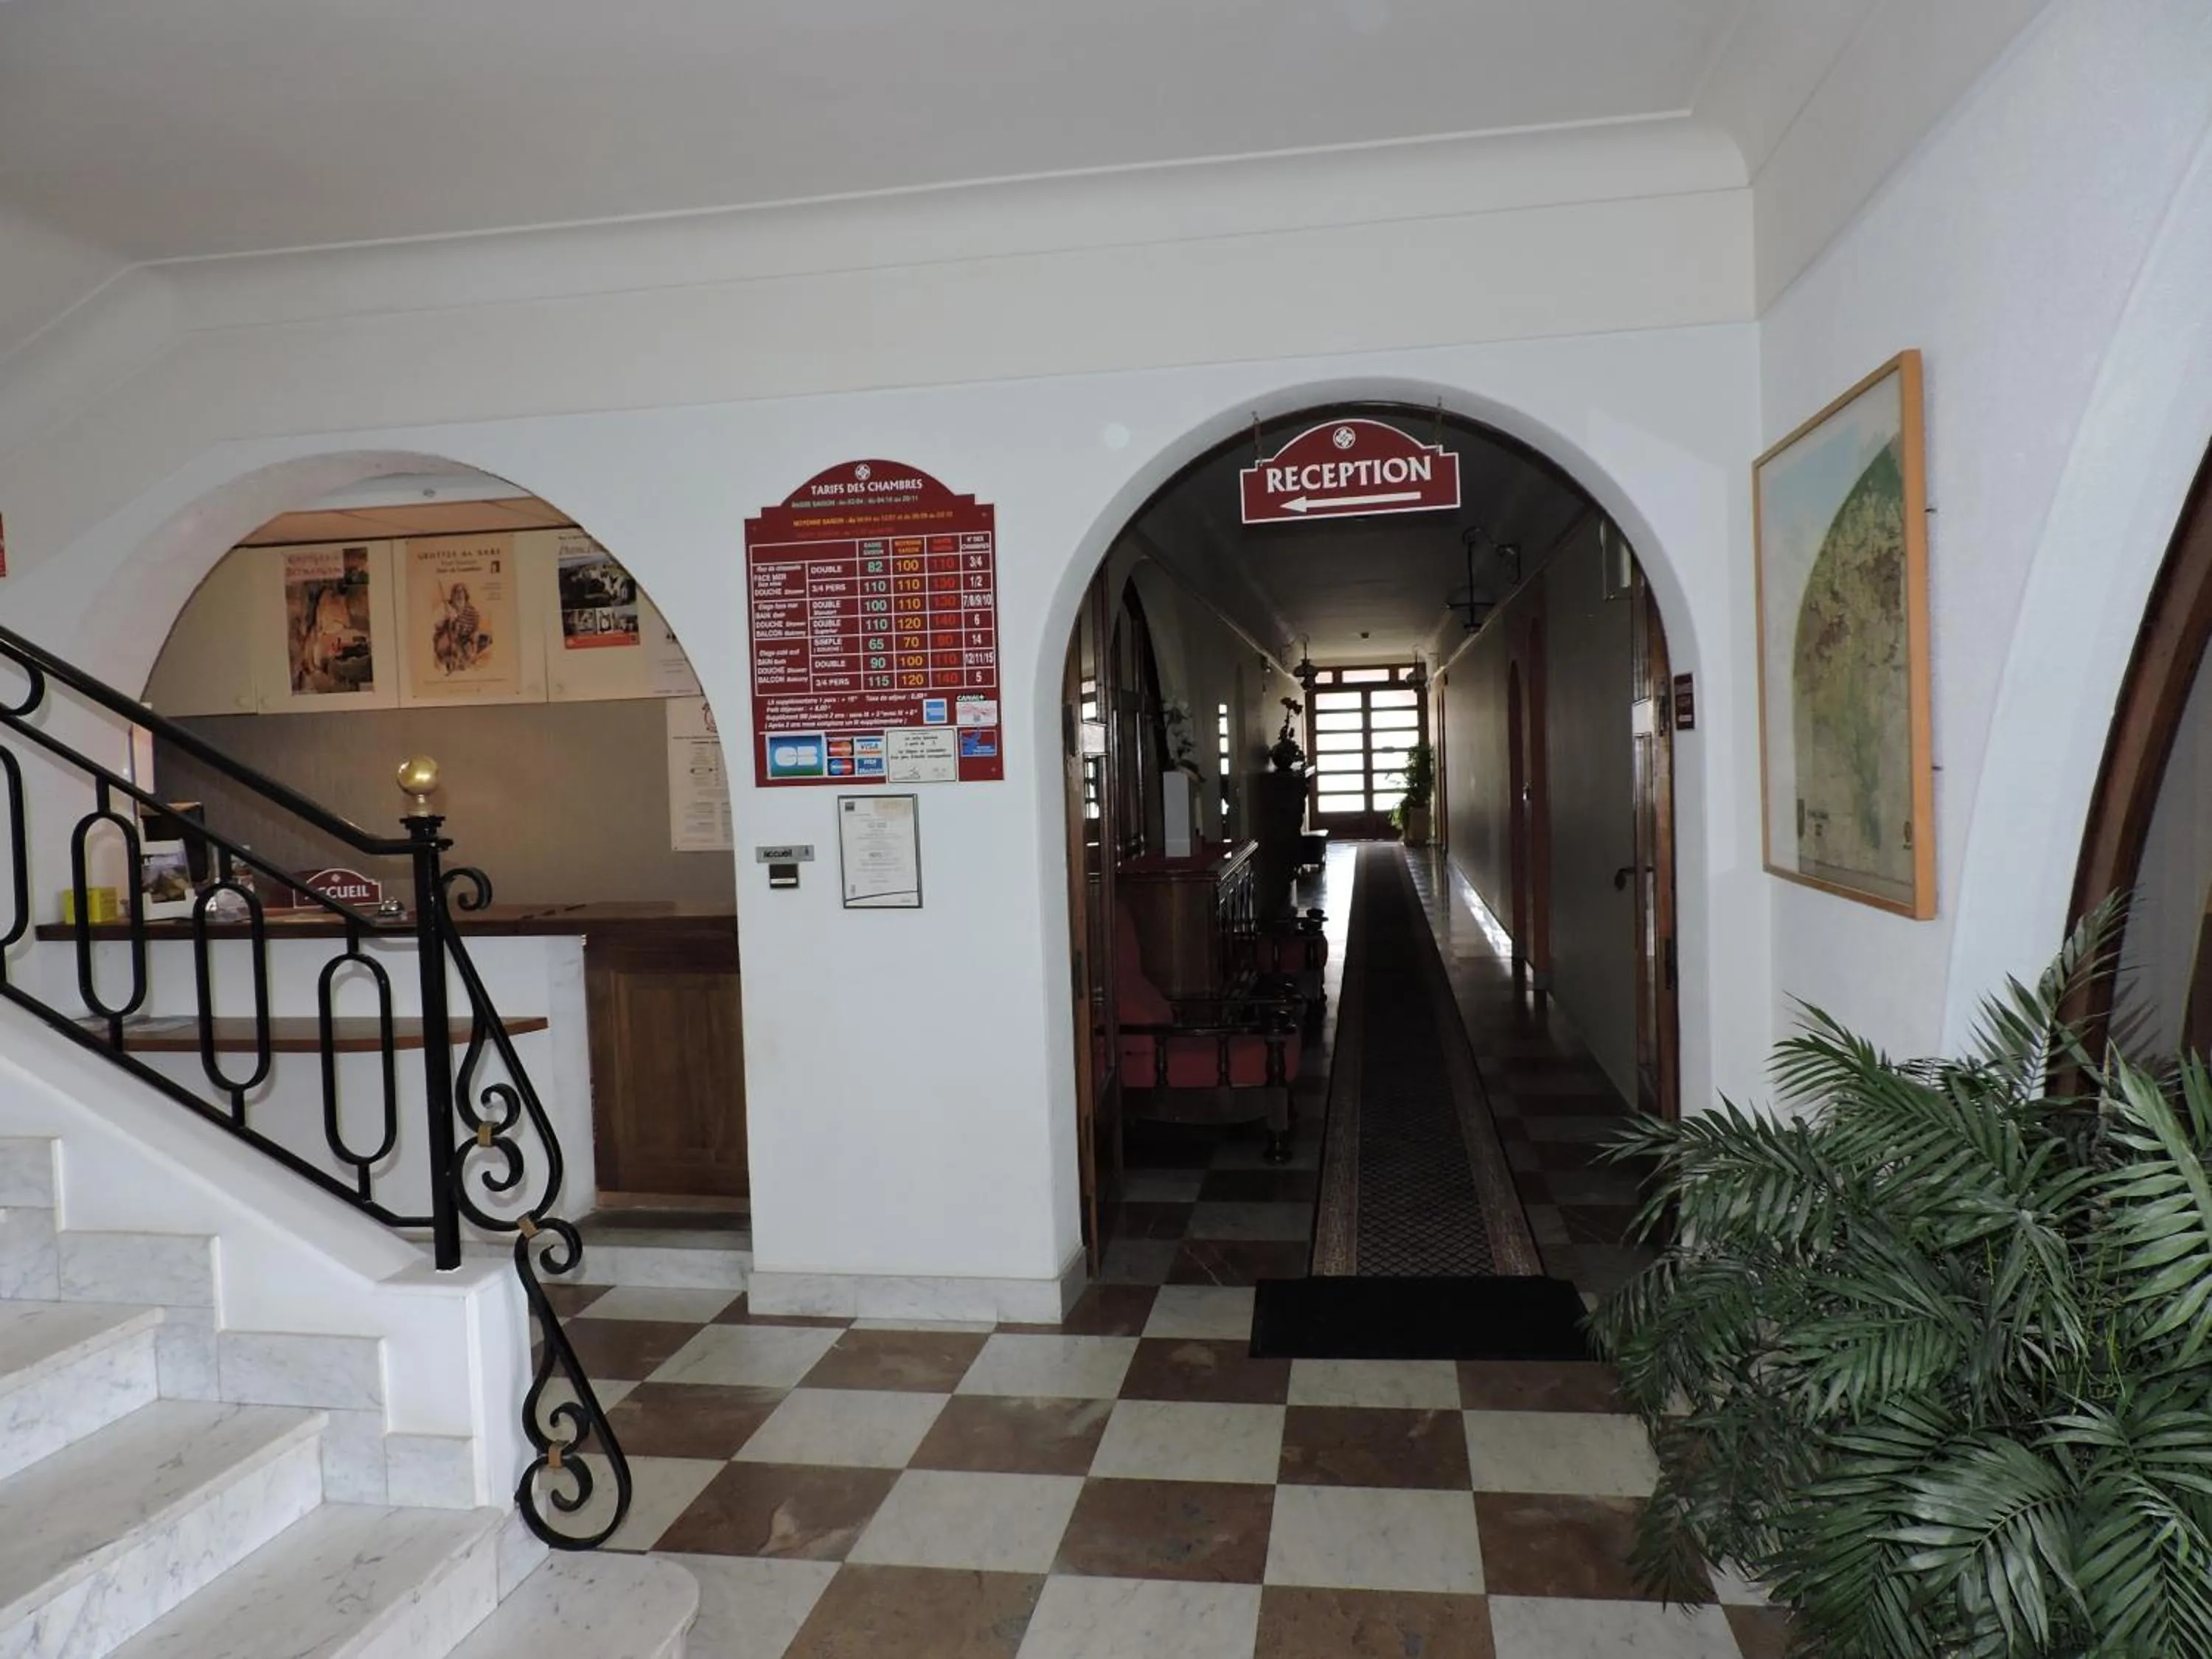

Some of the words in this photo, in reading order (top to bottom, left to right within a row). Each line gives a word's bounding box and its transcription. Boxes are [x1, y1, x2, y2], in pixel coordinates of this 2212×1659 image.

[1266, 455, 1432, 493] RECEPTION
[811, 484, 844, 495] TARIFS
[847, 482, 866, 493] DES
[868, 479, 922, 492] CHAMBRES
[896, 560, 919, 571] 100
[933, 557, 955, 569] 110
[970, 556, 983, 568] 3/4
[864, 581, 886, 591] 110
[897, 580, 920, 590] 110
[970, 576, 983, 588] 1/2
[813, 600, 841, 608] DOUBLE
[865, 600, 886, 611] 100
[898, 598, 921, 610] 110
[866, 619, 888, 630] 110
[897, 617, 921, 629] 120
[974, 613, 980, 625] 6
[868, 639, 884, 650] 65
[903, 637, 919, 647] 70
[972, 634, 982, 644] 14
[815, 660, 846, 668] DOUBLE
[870, 657, 886, 669] 90
[900, 656, 922, 666] 100
[936, 655, 956, 664] 110
[829, 678, 849, 686] PERS
[868, 676, 889, 686] 115
[902, 674, 924, 685] 120
[936, 673, 957, 684] 140
[975, 671, 982, 682] 5
